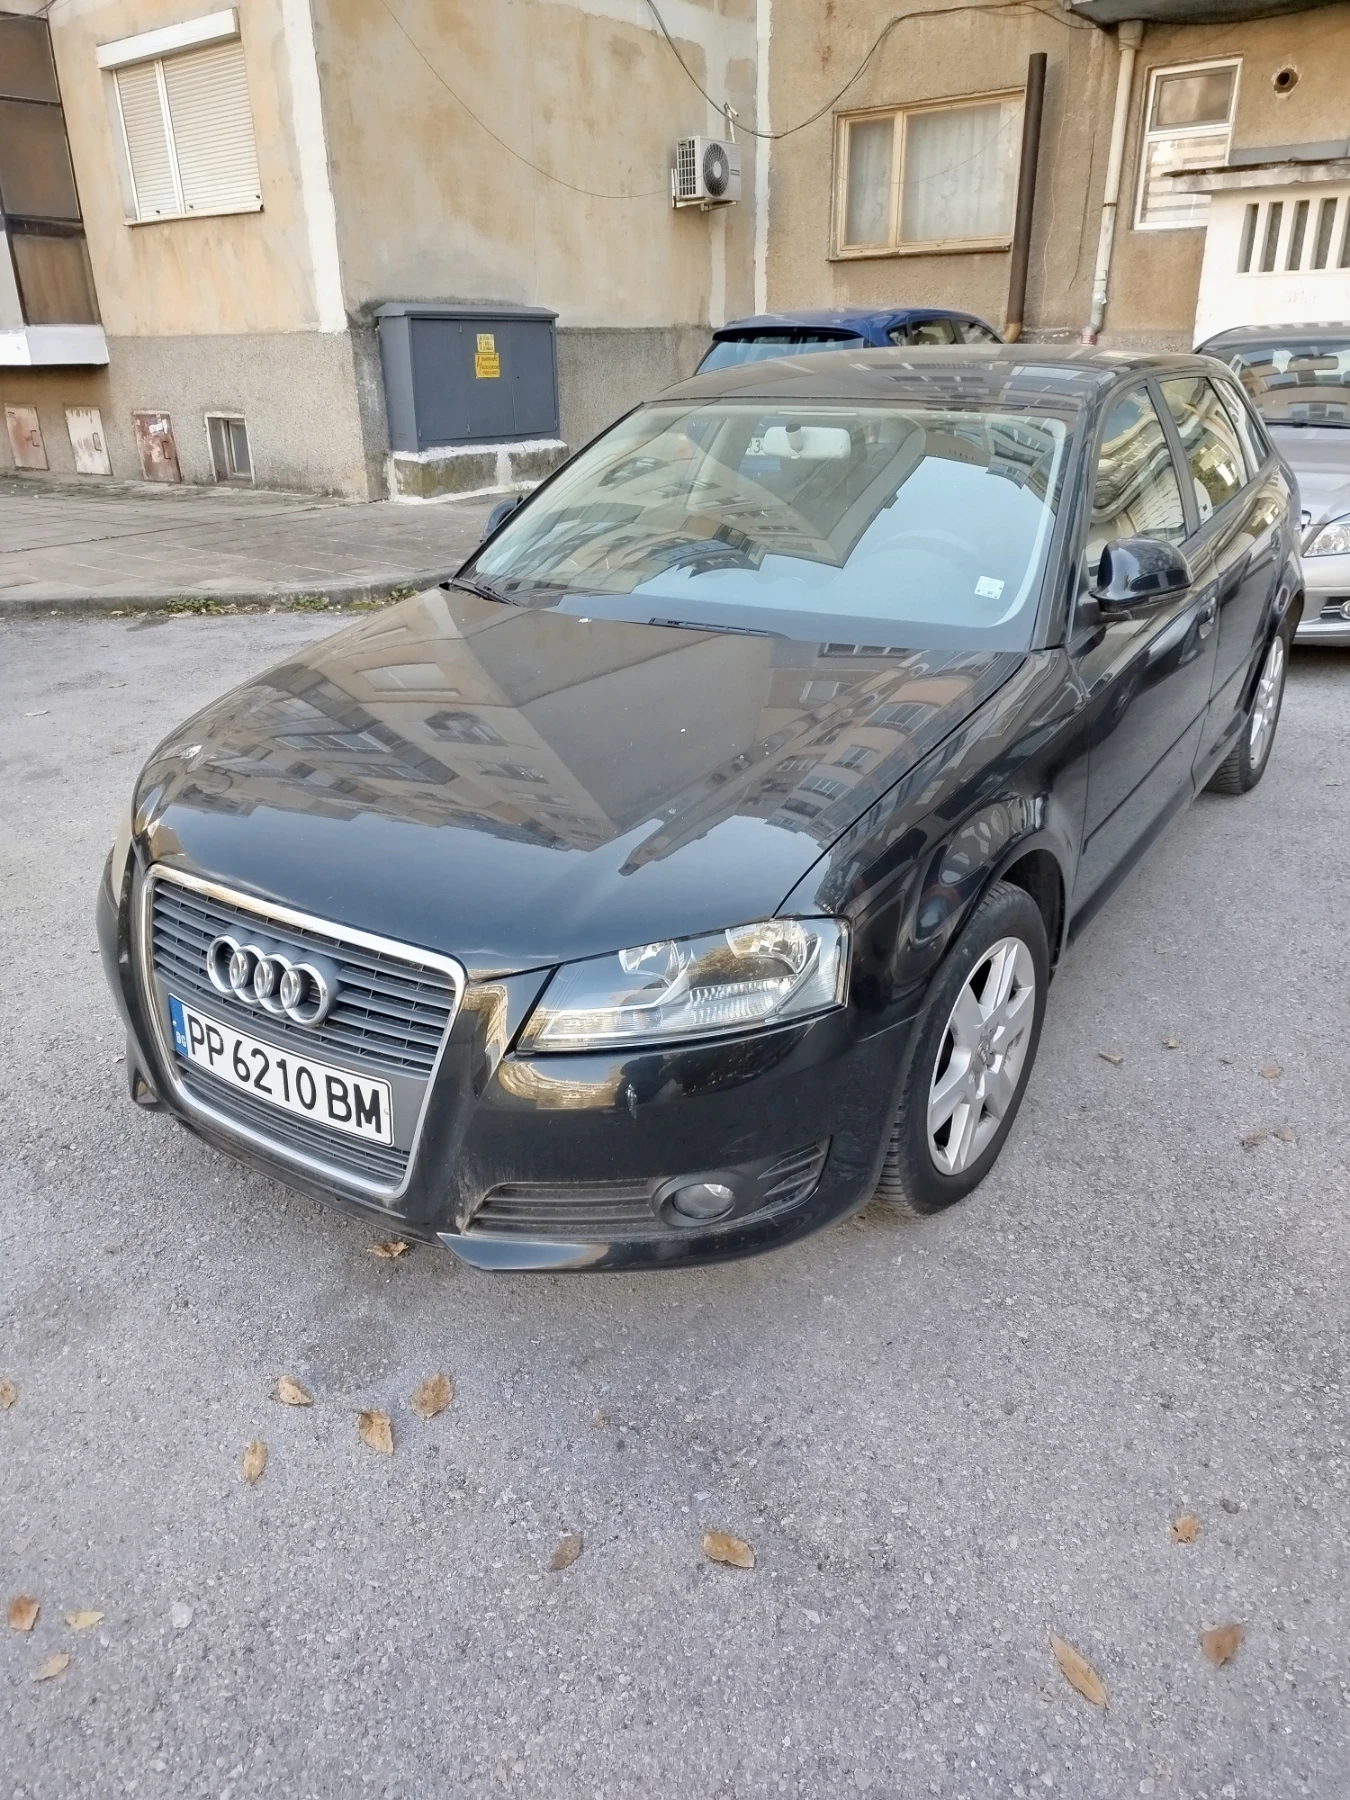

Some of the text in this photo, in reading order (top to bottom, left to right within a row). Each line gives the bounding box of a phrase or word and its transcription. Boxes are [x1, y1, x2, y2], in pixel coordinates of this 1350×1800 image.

[175, 1031, 187, 1048] BG
[187, 1013, 382, 1134] PP 6210 BM
